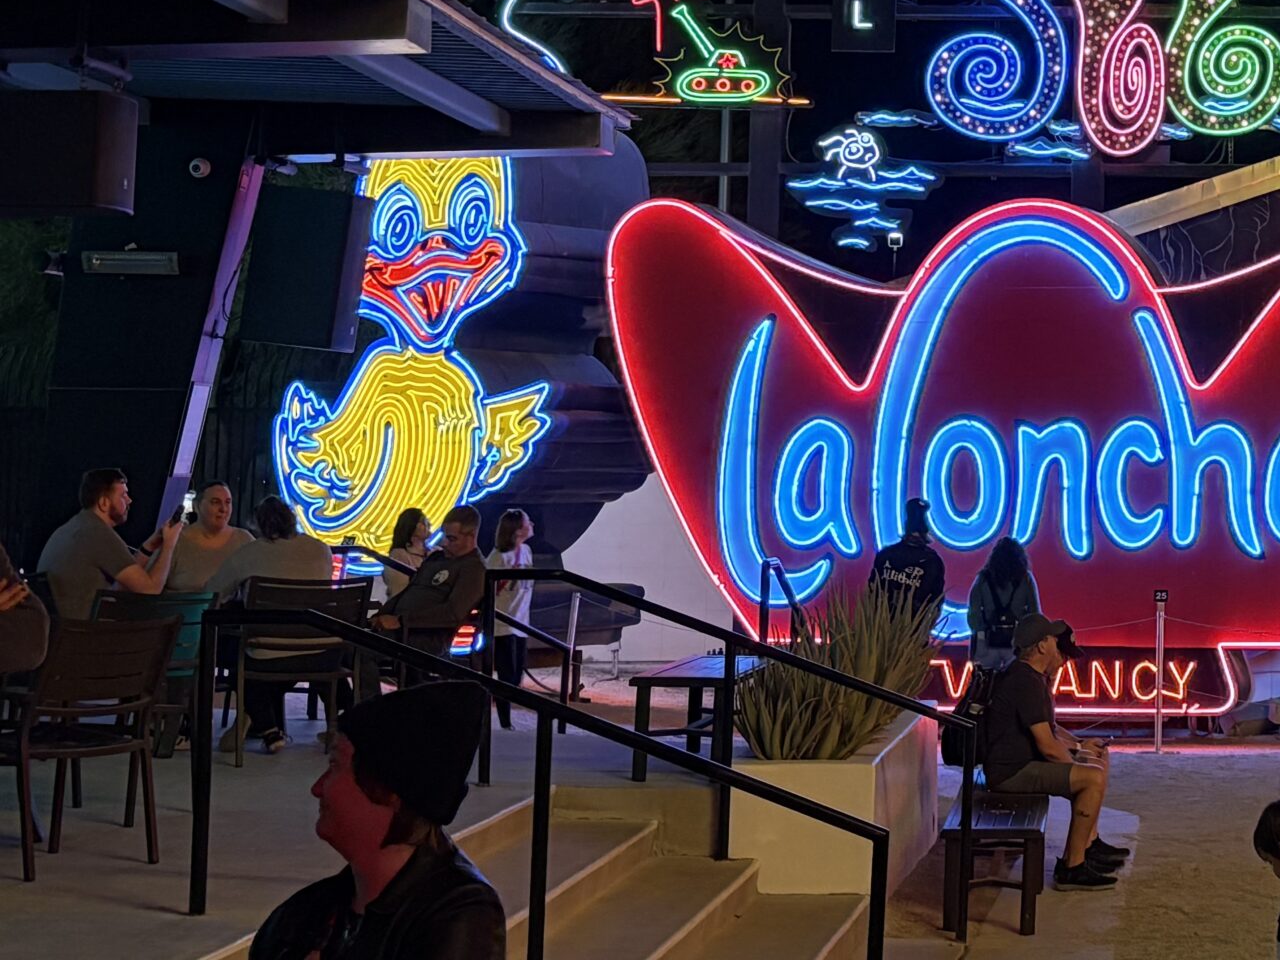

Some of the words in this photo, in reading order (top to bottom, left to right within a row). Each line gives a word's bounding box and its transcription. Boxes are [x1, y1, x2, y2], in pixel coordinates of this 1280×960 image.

[716, 315, 862, 607] La
[1154, 591, 1168, 600] 25
[936, 657, 1197, 701] VANCY
